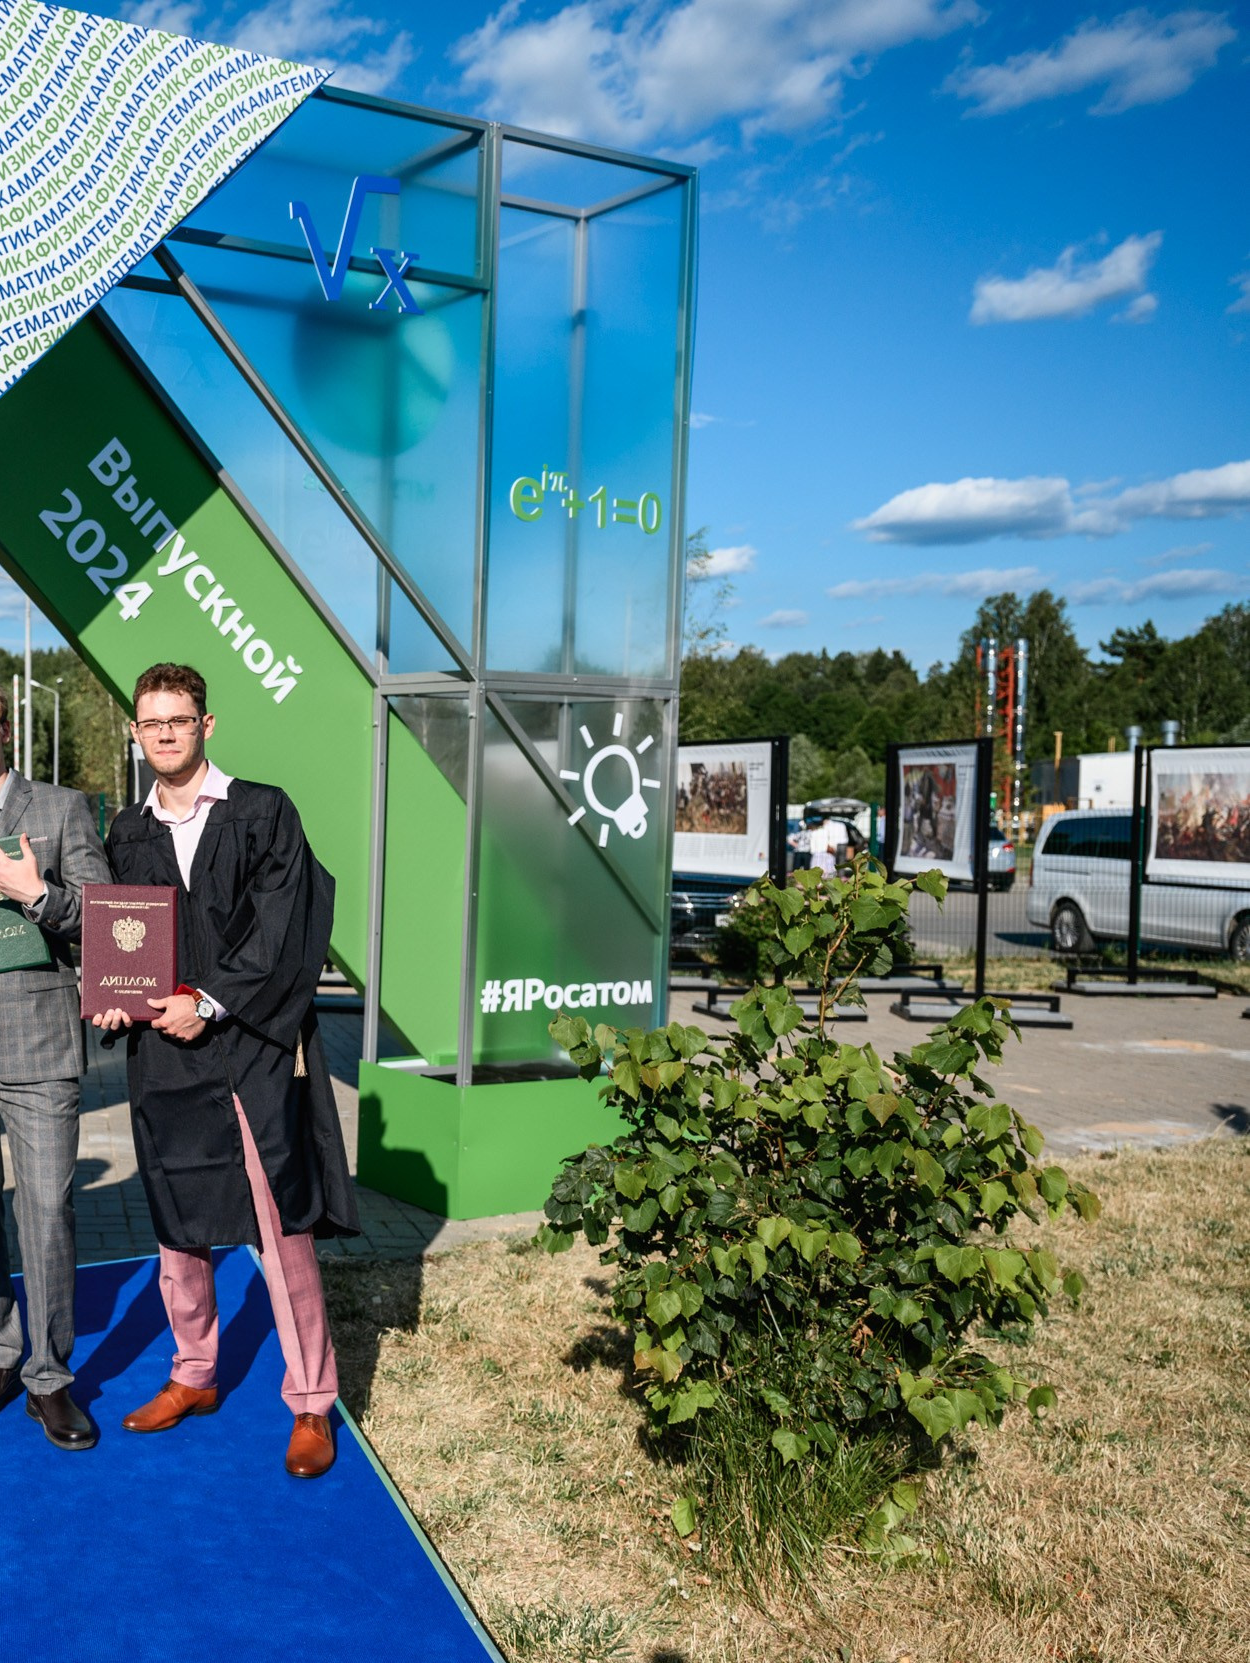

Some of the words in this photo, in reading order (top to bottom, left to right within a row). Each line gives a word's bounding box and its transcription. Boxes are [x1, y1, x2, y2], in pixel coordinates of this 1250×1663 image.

[38, 487, 154, 622] 2024
[87, 436, 304, 705] Выпускной
[99, 975, 158, 988] ДИПЛОМ
[480, 978, 653, 1013] #ЯРосатом
